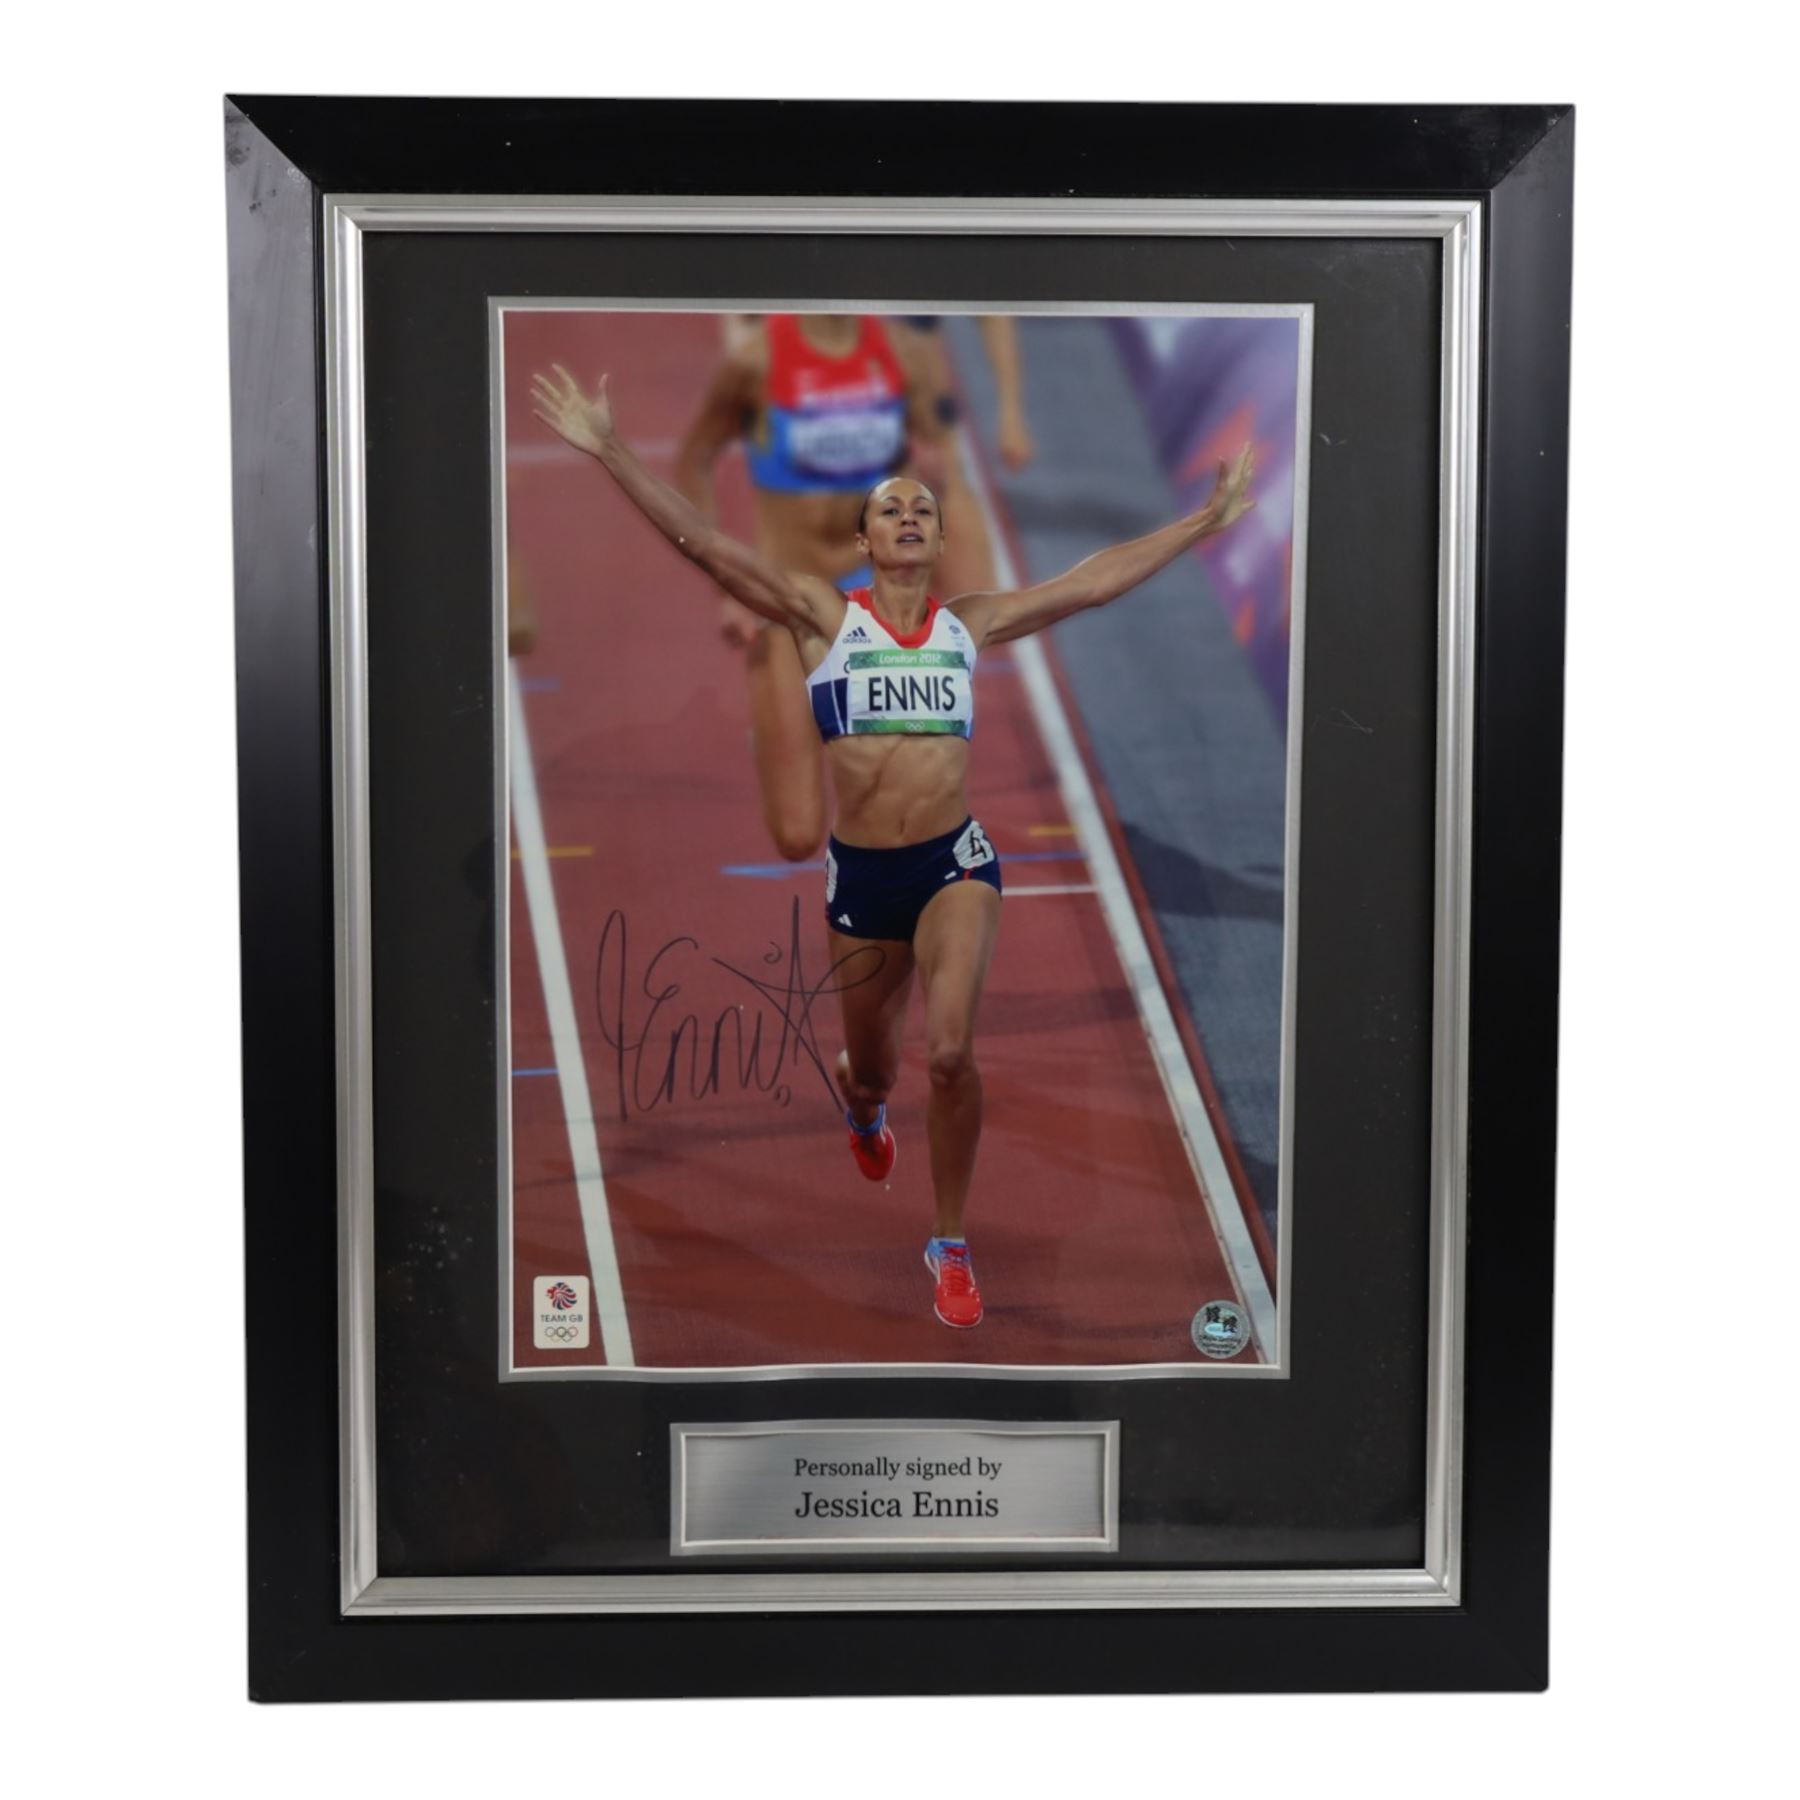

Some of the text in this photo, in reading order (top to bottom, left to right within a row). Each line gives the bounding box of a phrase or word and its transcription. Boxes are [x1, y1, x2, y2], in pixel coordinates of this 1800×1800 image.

[842, 635, 872, 644] adidas
[879, 653, 942, 664] London 2012
[868, 674, 956, 712] ENNIS
[970, 831, 987, 859] 4
[540, 1314, 583, 1323] TEAM GB
[794, 1457, 1003, 1480] Personally signed by
[795, 1490, 1000, 1519] Jessica Ennis
